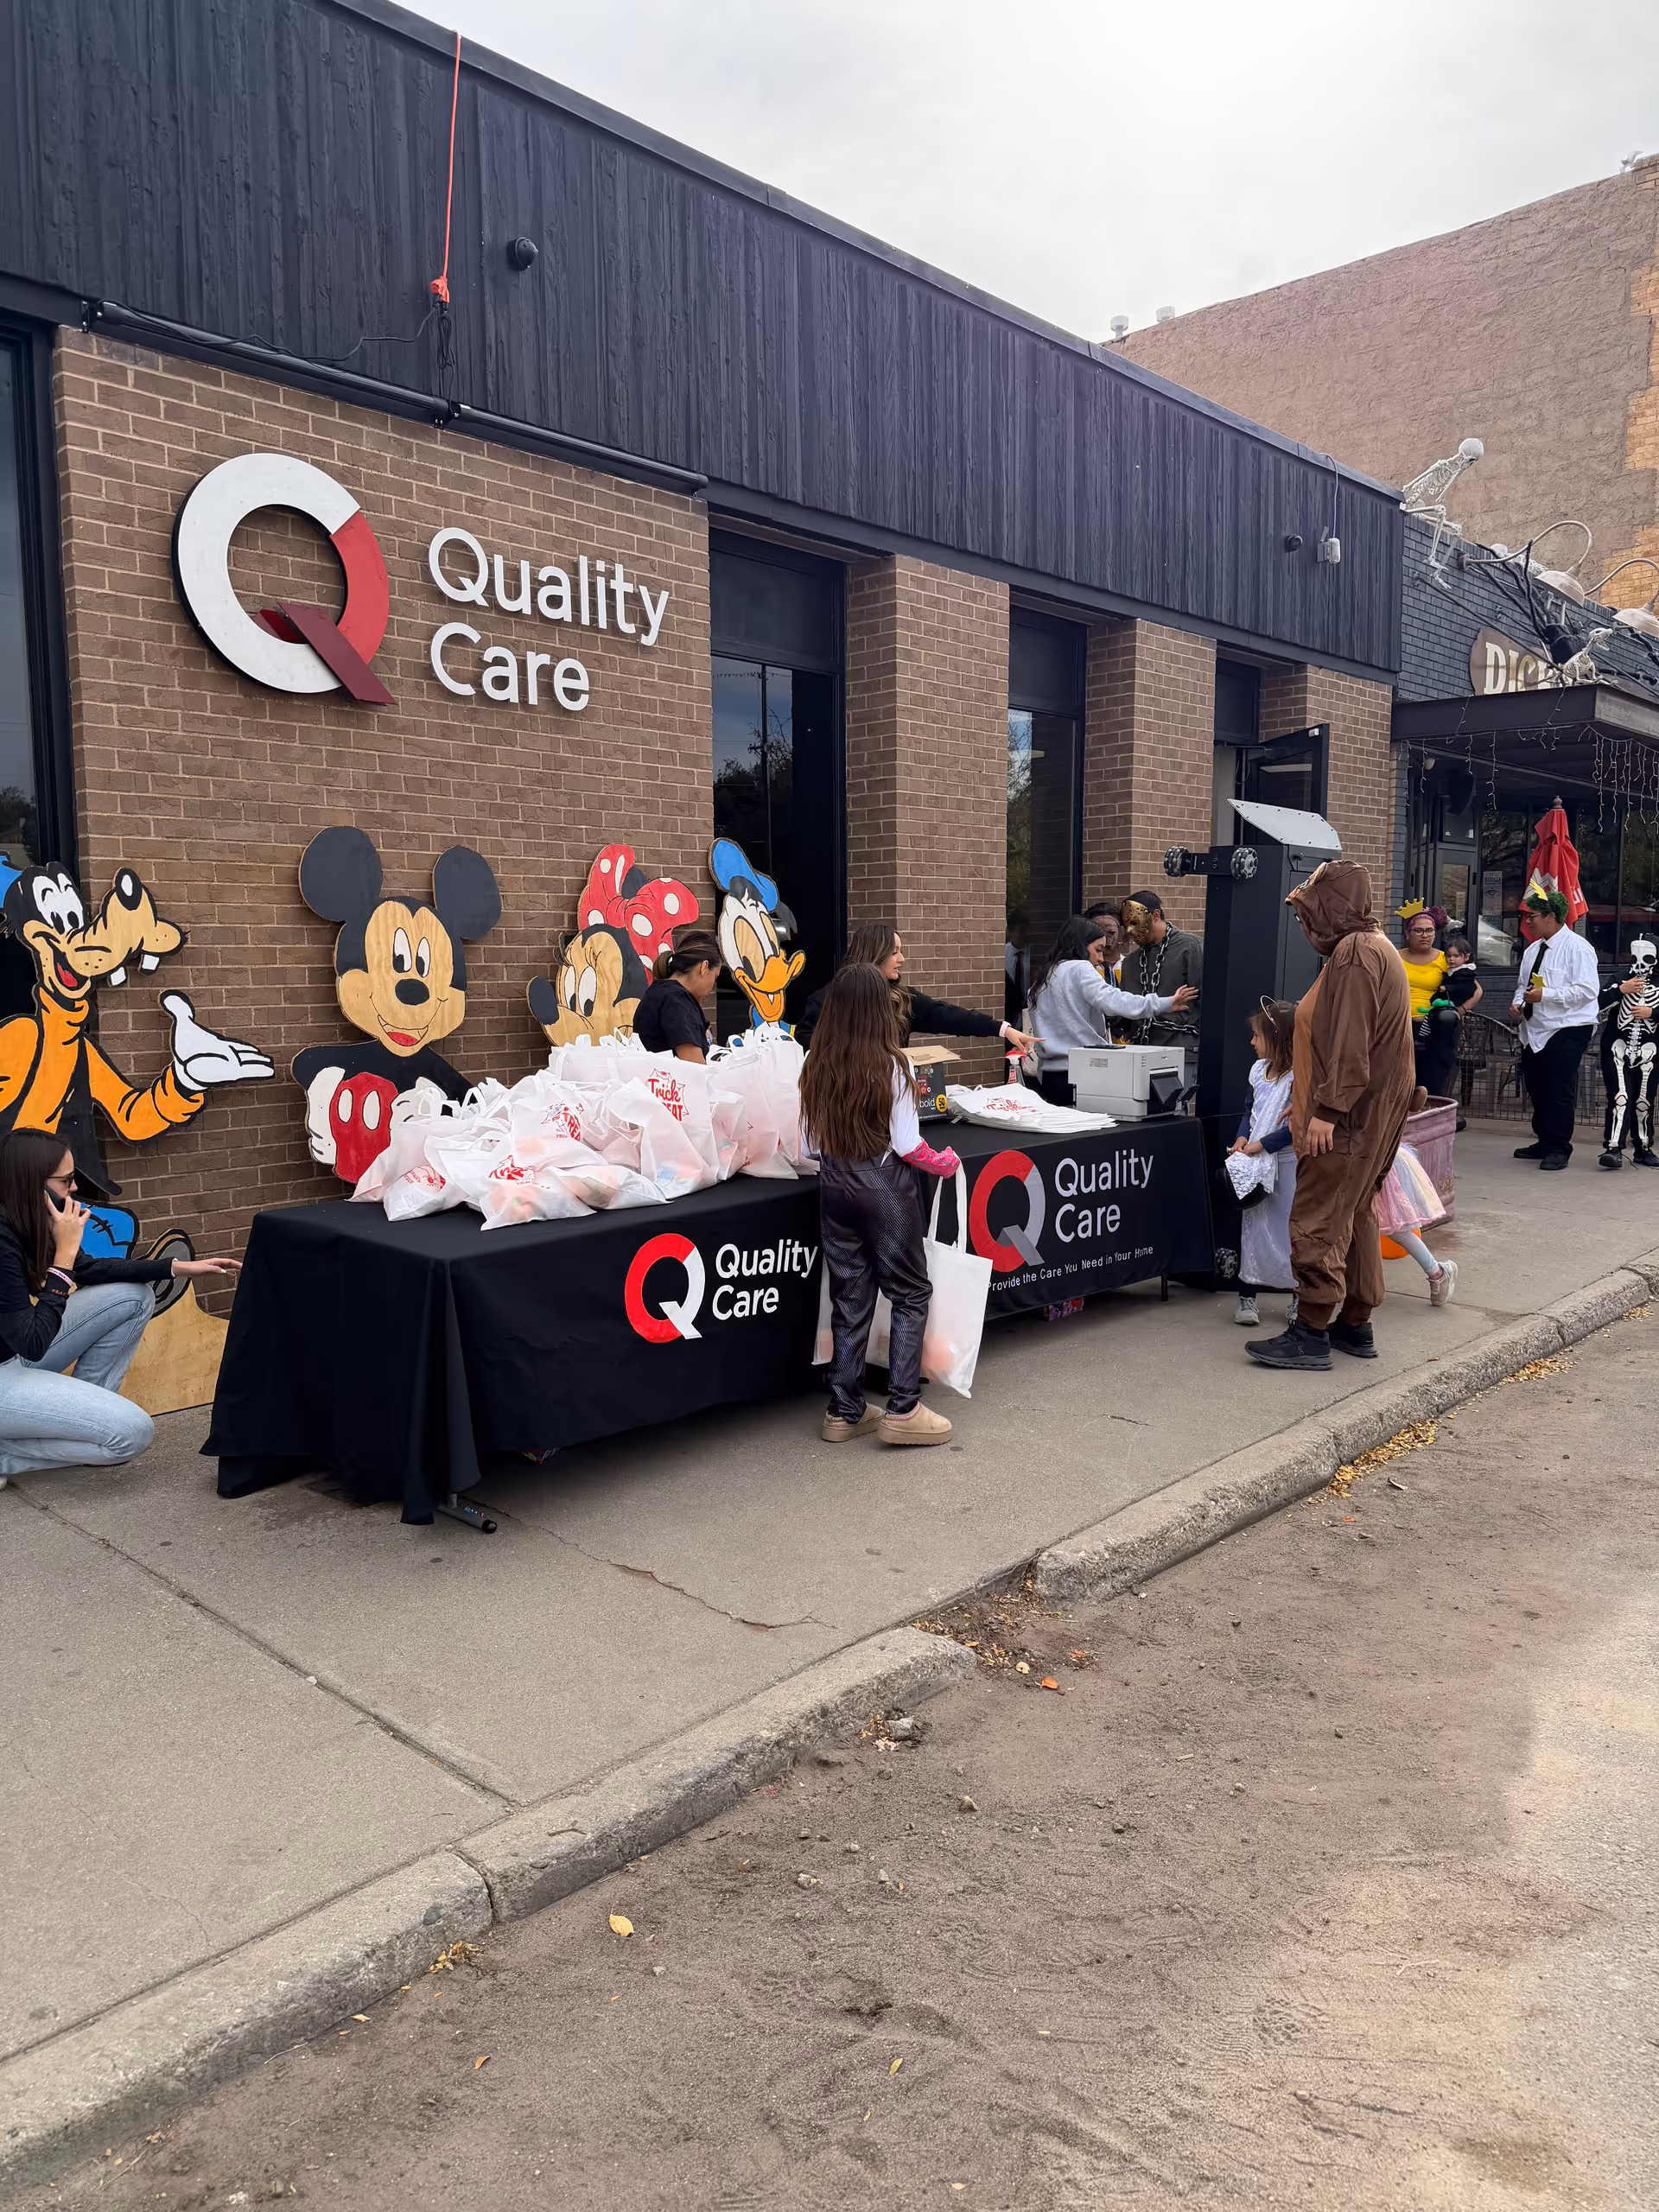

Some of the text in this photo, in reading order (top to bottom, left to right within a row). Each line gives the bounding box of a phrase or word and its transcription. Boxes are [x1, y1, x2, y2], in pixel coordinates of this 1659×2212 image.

[428, 526, 670, 646] Quality
[429, 621, 590, 712] Care
[647, 1078, 681, 1103] Trick
[938, 1096, 945, 1107] 50
[1054, 1148, 1154, 1198] Quality
[1054, 1203, 1122, 1243] Care
[715, 1238, 818, 1279] Quality
[1022, 1272, 1037, 1283] the
[1039, 1268, 1062, 1280] Care
[1065, 1262, 1077, 1274] You
[1081, 1256, 1103, 1270] Need
[1105, 1255, 1113, 1265] in
[1114, 1251, 1132, 1262] Your
[1135, 1245, 1154, 1258] Home
[711, 1285, 779, 1321] Care
